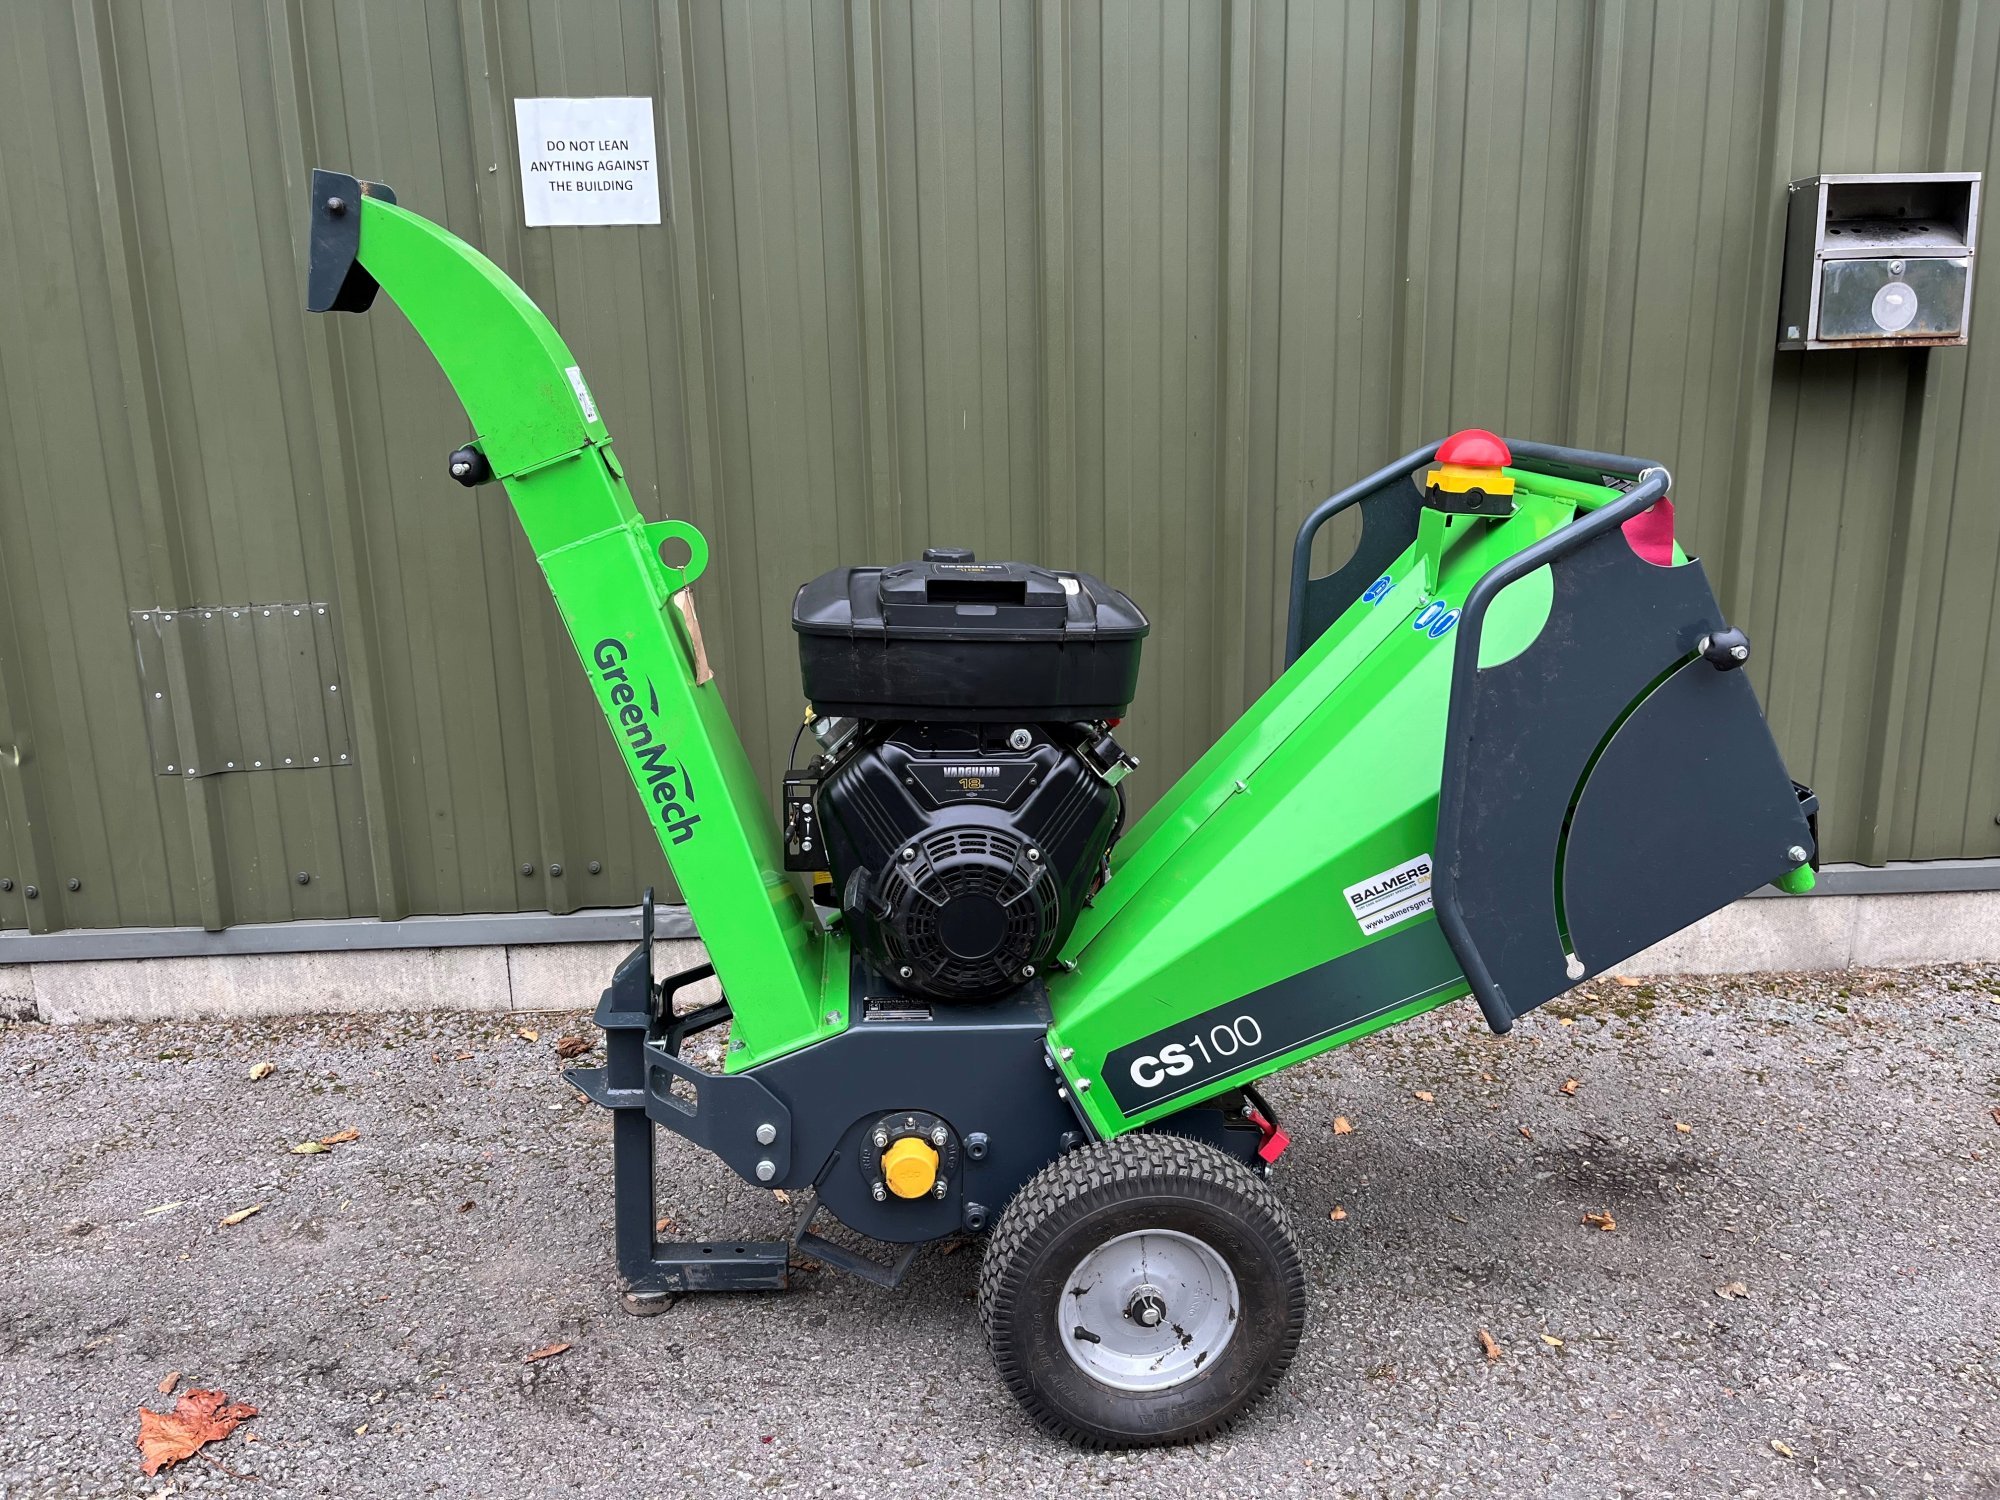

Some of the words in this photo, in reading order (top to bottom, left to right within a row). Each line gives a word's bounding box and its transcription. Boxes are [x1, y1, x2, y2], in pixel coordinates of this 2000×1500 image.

[547, 140, 565, 151] DO
[569, 140, 595, 151] NOT
[598, 139, 629, 151] LEAN
[530, 160, 594, 172] ANYTHING
[597, 160, 649, 171] AGAINST
[549, 180, 573, 192] THE
[576, 180, 633, 192] BUILDING
[593, 638, 701, 846] GreenMech
[943, 766, 1000, 778] VANGUARD
[1350, 863, 1430, 905] BALMERS
[1130, 1015, 1262, 1088] CS100
